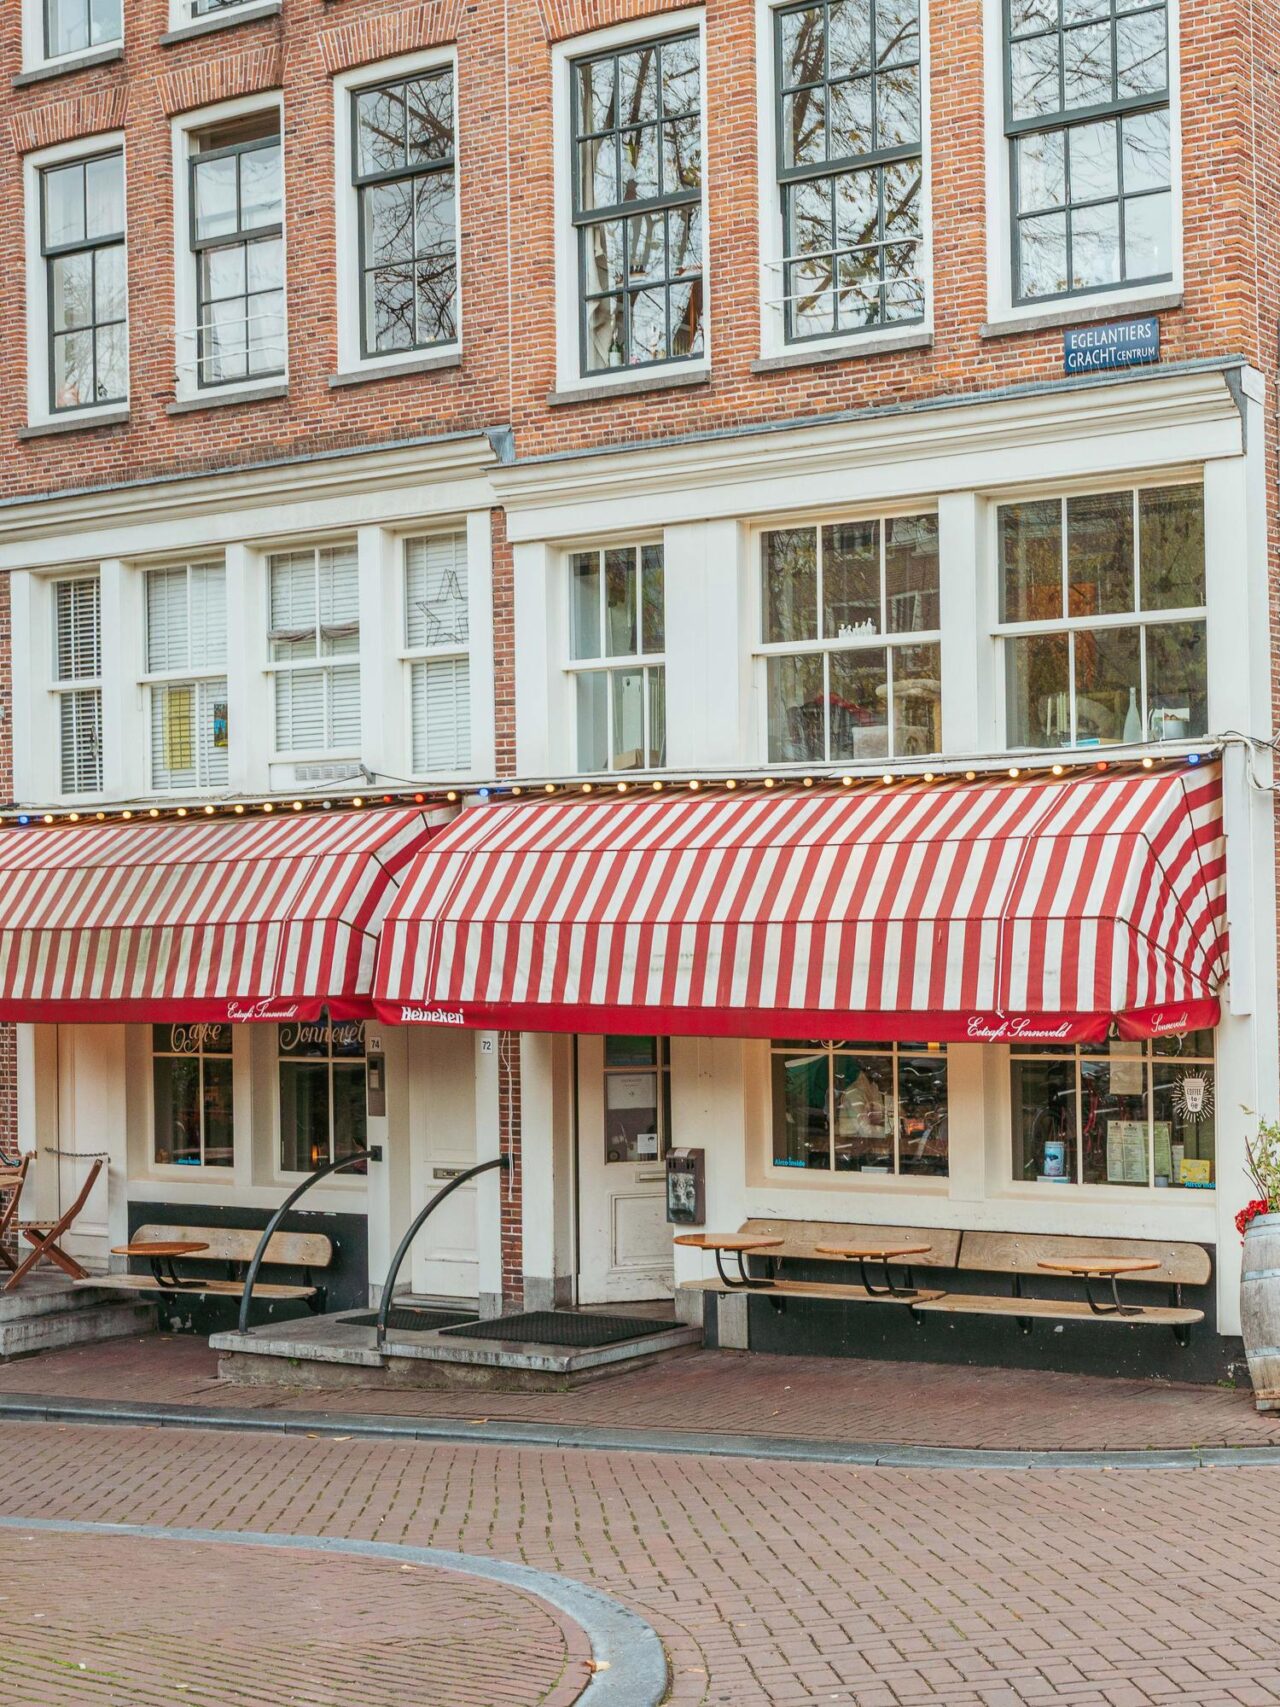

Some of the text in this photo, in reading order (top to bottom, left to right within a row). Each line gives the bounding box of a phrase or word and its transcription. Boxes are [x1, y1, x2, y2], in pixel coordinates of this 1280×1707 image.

[1071, 323, 1151, 349] EGELANTIERS
[1068, 347, 1155, 367] GRACHT CENTRUM
[401, 1006, 464, 1024] Heineken
[1151, 1012, 1188, 1032] Sonneveld
[1007, 1018, 1072, 1038] Sonneveld
[371, 1040, 380, 1049] 74
[482, 1041, 491, 1050] 72
